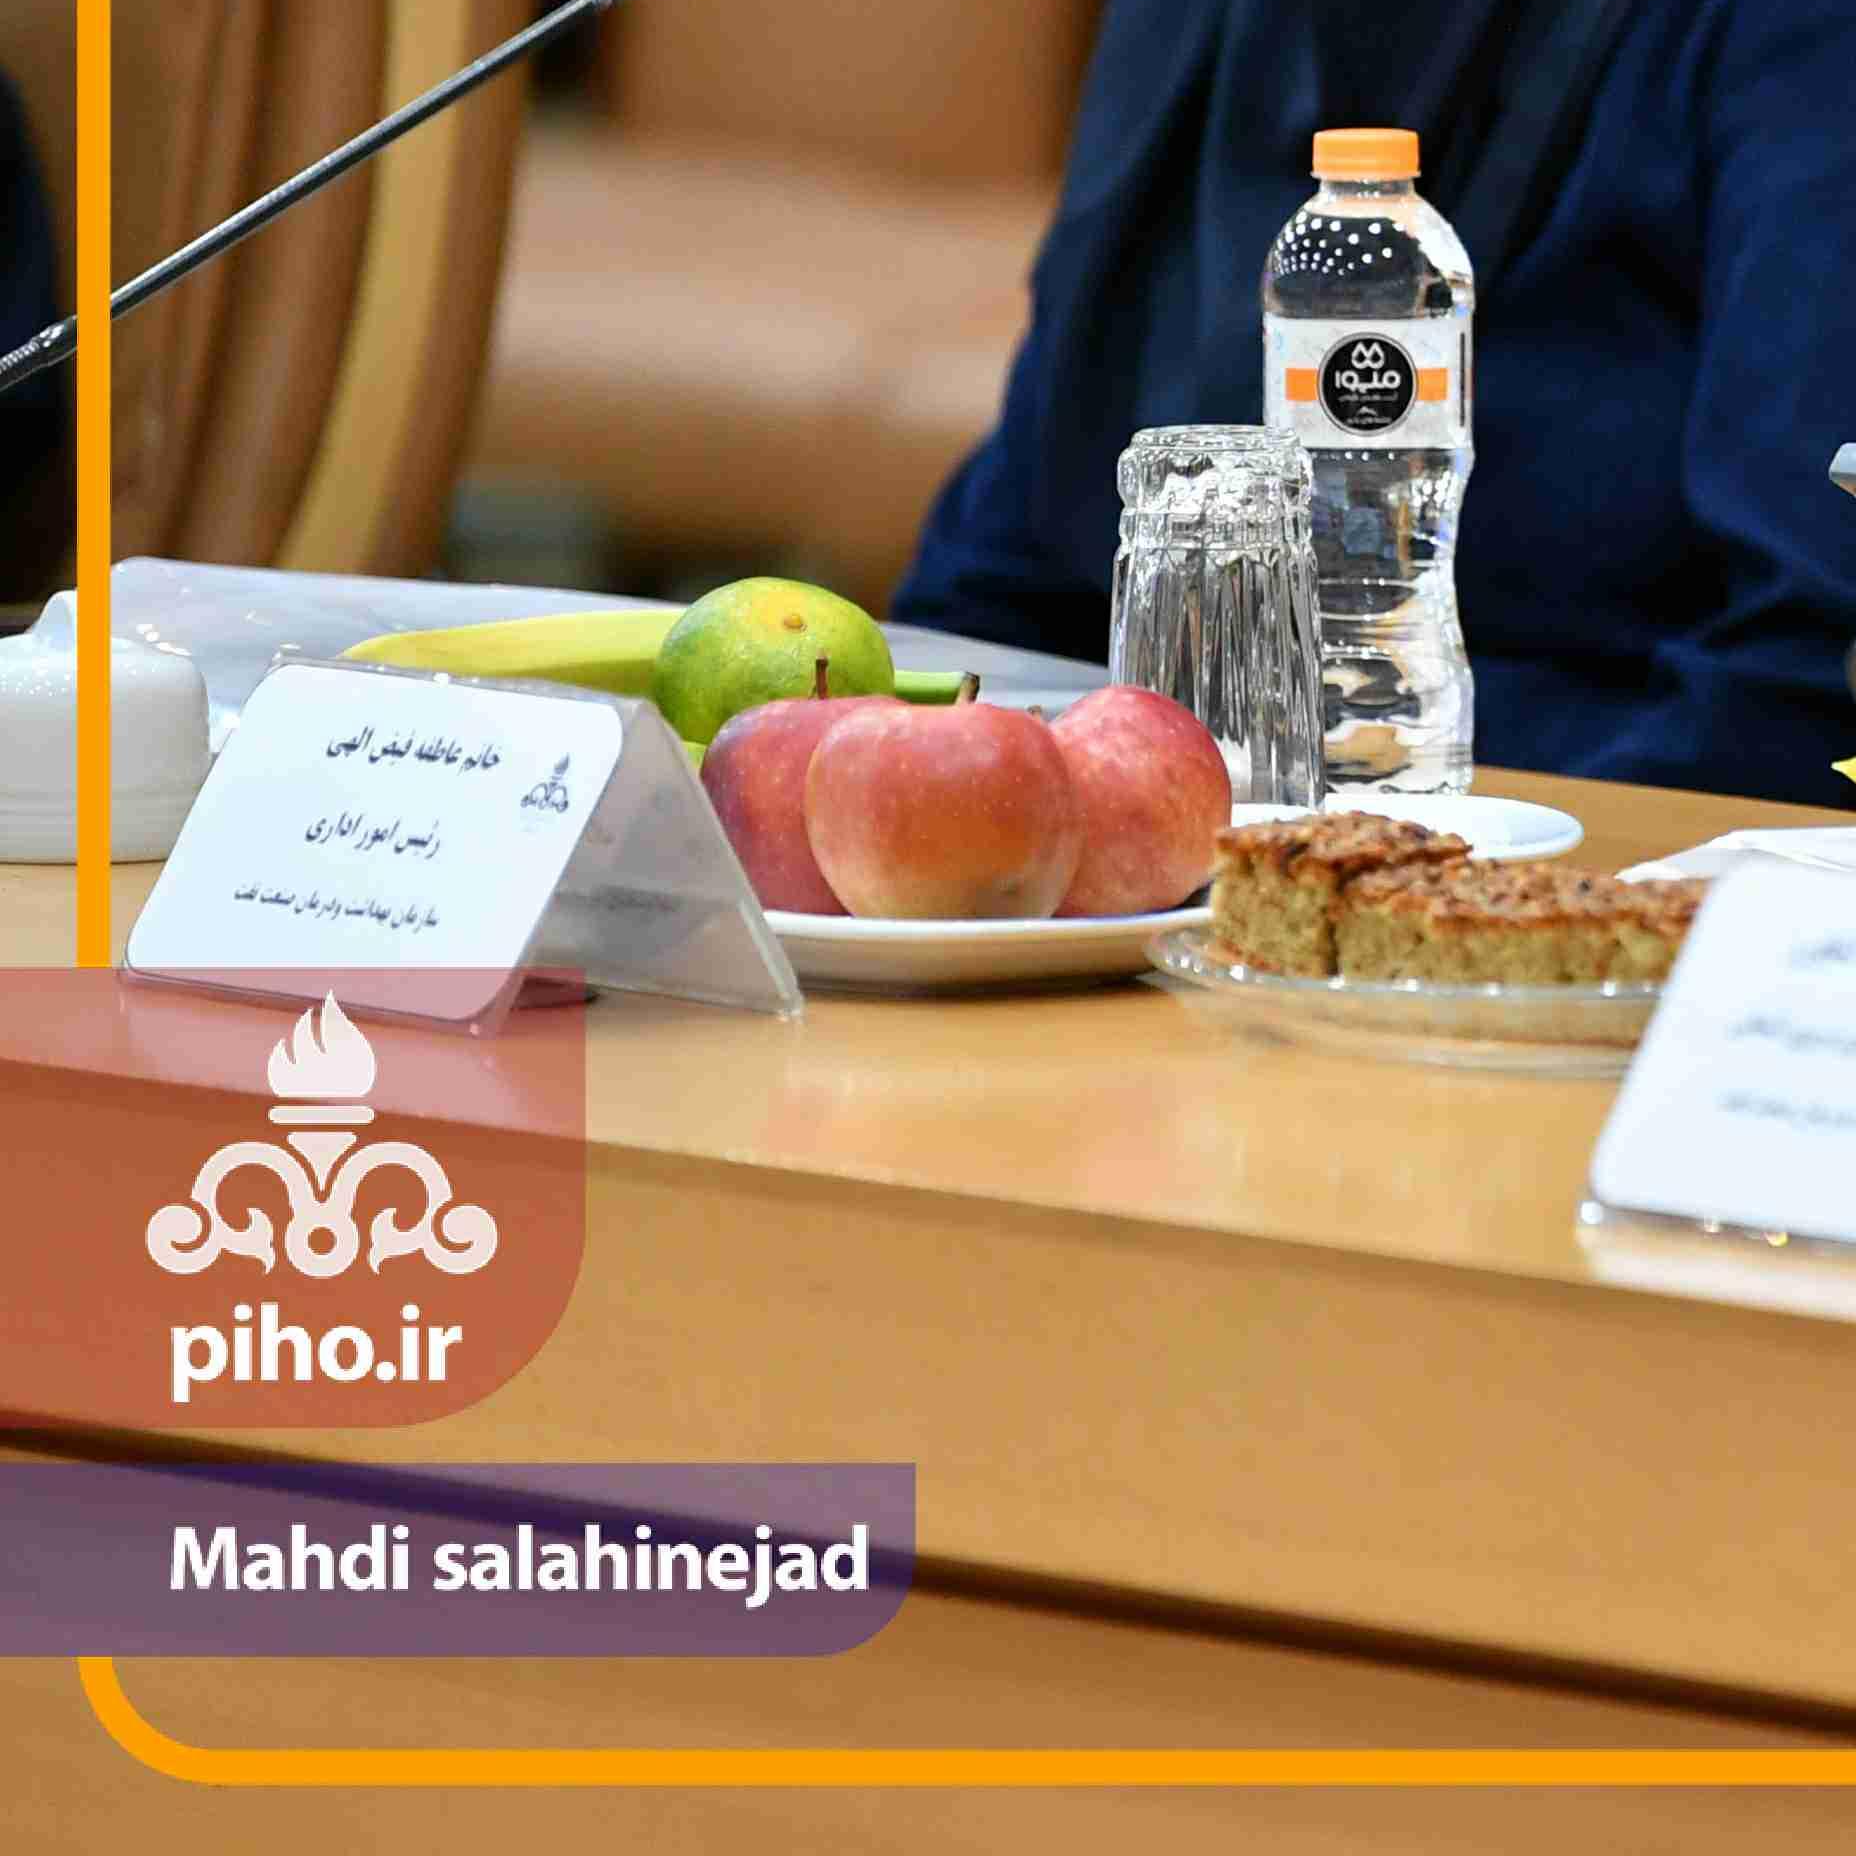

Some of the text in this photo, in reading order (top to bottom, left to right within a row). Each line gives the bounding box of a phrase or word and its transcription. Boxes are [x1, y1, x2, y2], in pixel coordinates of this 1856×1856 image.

[325, 725, 501, 776] خانم عاطفه فیض الهی
[304, 810, 441, 860] رئیس امور اداری
[234, 882, 260, 901] نفت
[259, 887, 297, 907] صنعت
[343, 896, 392, 925] بهداشت
[391, 903, 438, 934] سازمان
